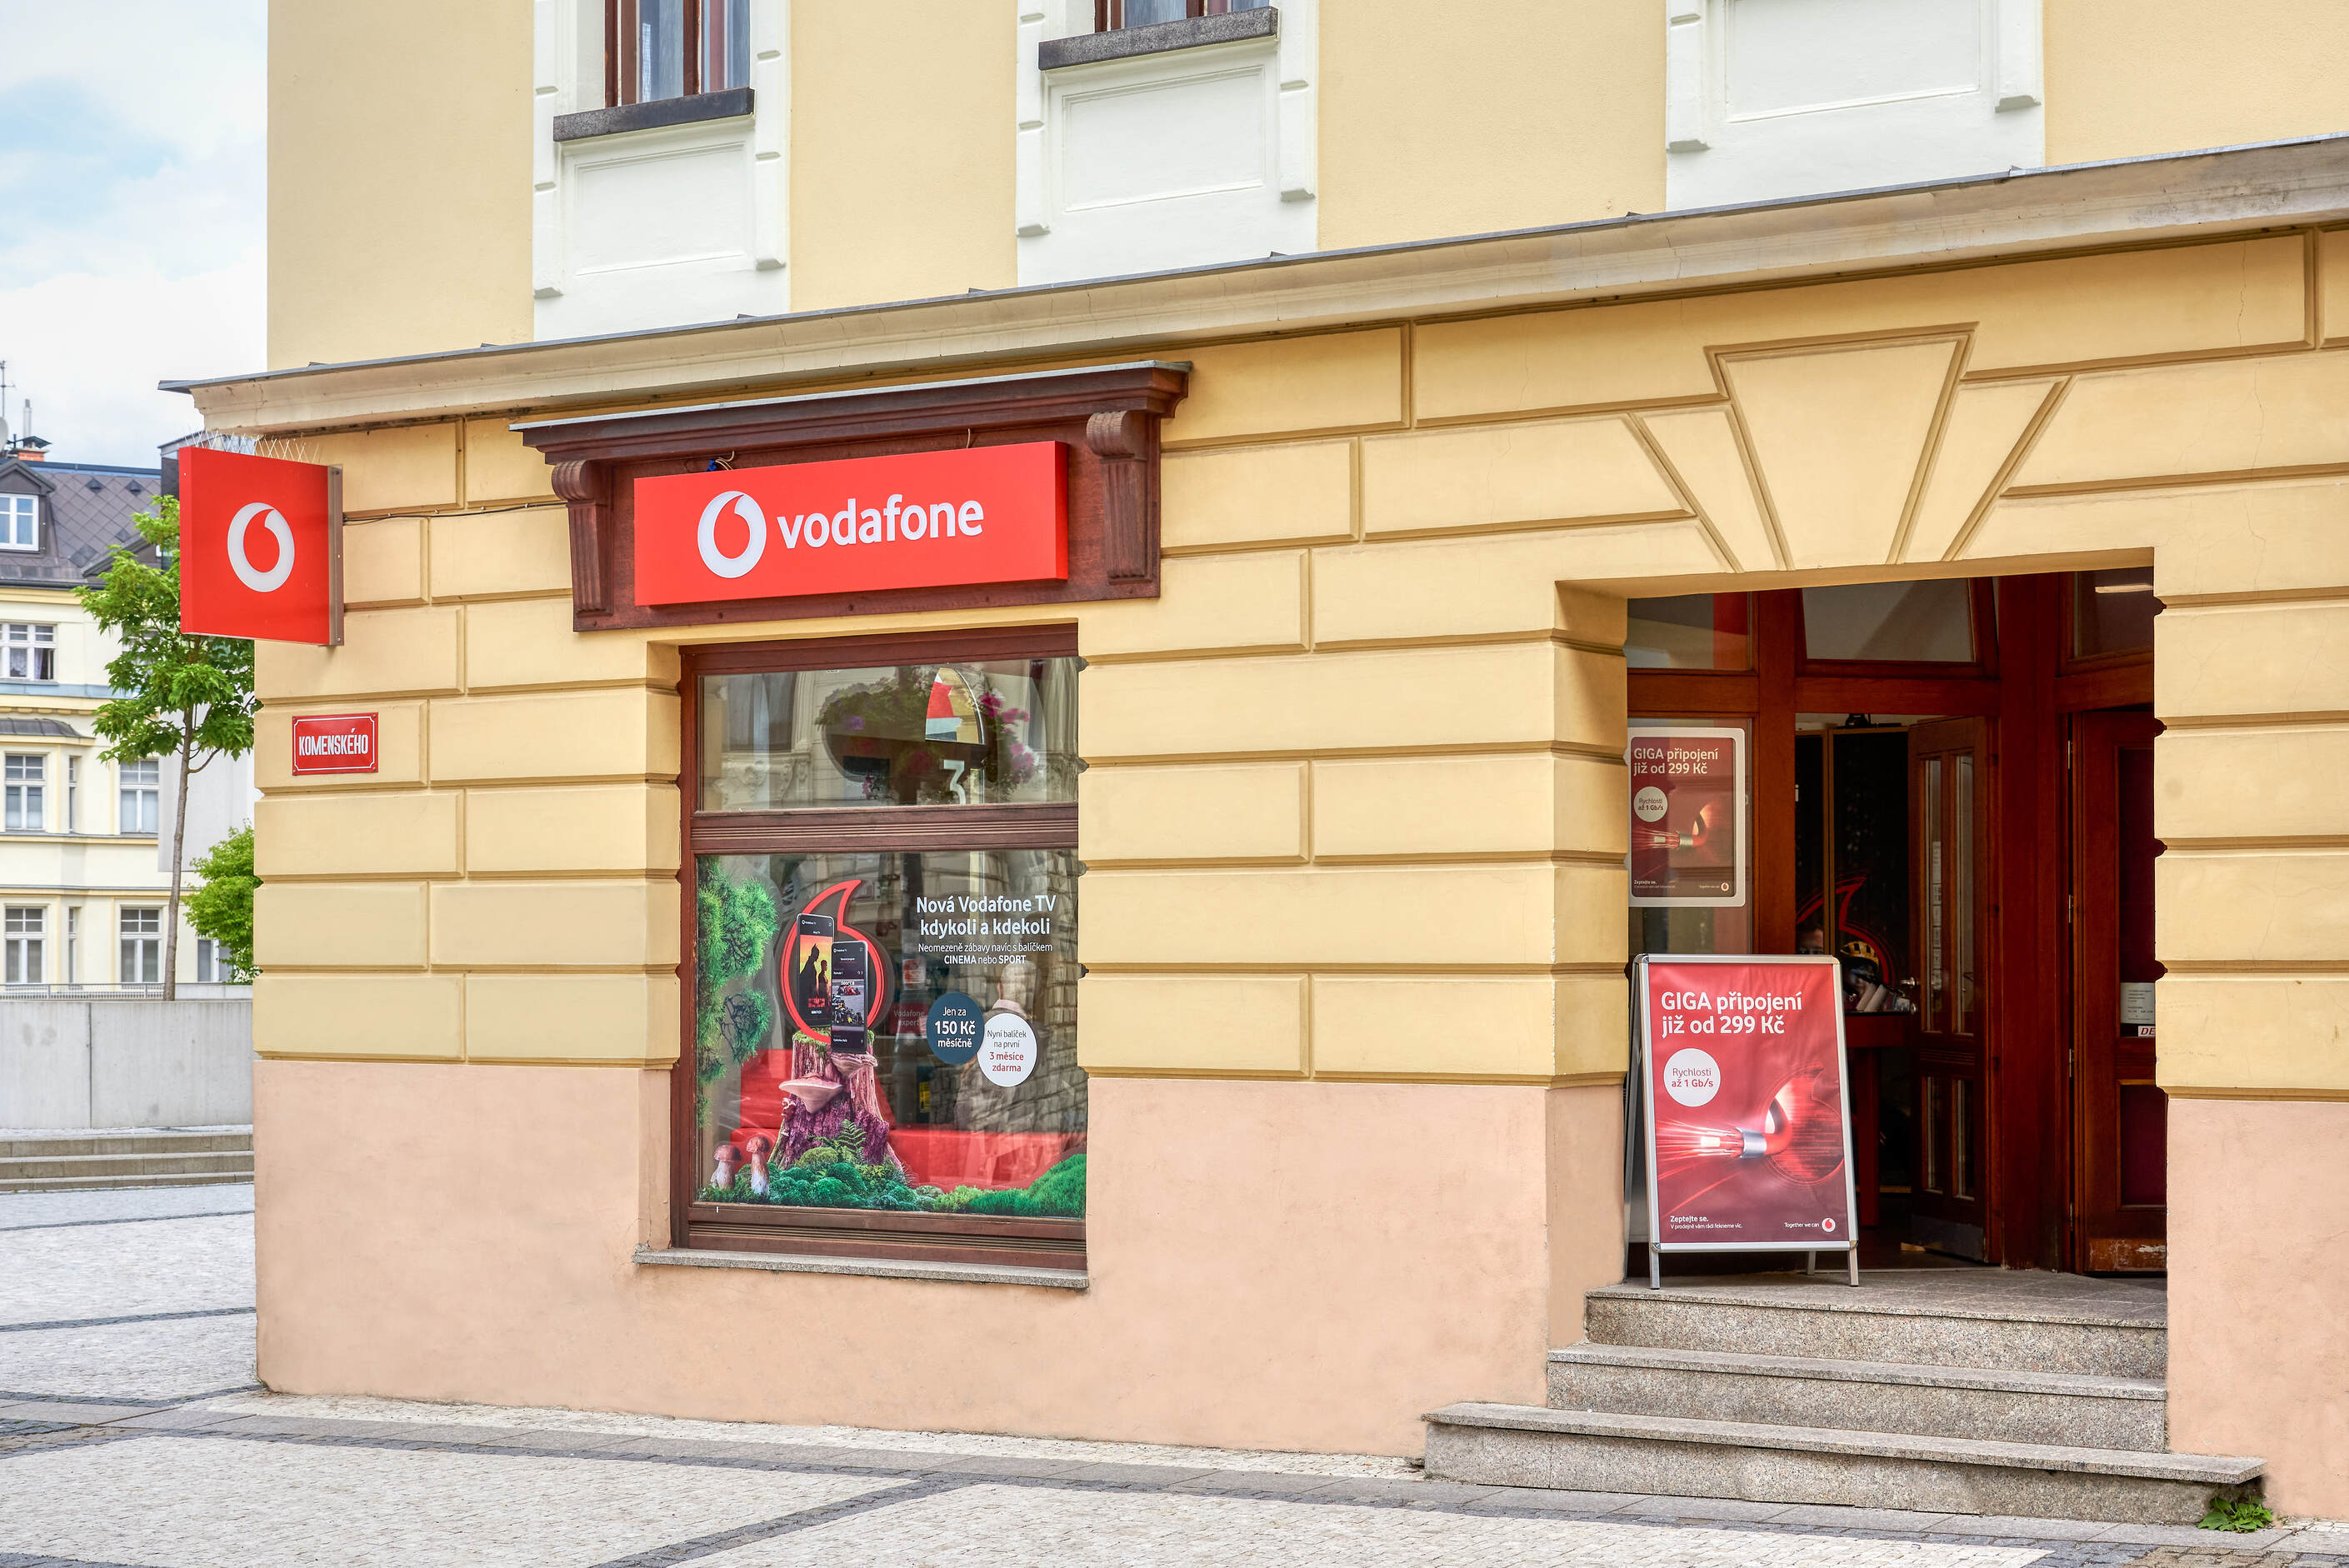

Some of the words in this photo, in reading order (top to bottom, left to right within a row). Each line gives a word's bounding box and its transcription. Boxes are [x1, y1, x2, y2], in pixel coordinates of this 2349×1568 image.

[777, 494, 984, 549] vodafone
[299, 727, 368, 756] KOMENSKÉHO
[1633, 747, 1664, 759] GIGA
[1667, 747, 1719, 762] připojení
[1633, 762, 1647, 777] již
[1650, 762, 1666, 774] od
[1668, 762, 1690, 774] 299
[1692, 762, 1707, 774] Kč
[917, 895, 955, 913] Nová
[958, 895, 1032, 913] Vodafone
[1035, 895, 1057, 912] TV
[920, 918, 977, 940] kdykoli
[980, 922, 989, 935] a
[992, 917, 1050, 935] kdekoli
[918, 942, 963, 952] Neomezeně
[964, 943, 991, 954] zábavy
[992, 943, 1011, 952] navíc
[1018, 942, 1052, 952] balíčkem
[944, 955, 977, 964] CINEMA
[977, 955, 997, 964] nebo
[998, 955, 1027, 964] SPORT
[1661, 991, 1712, 1011] GIGA
[1717, 991, 1802, 1015] připojení
[942, 1006, 957, 1016] Jen
[957, 1008, 967, 1016] za
[934, 1020, 957, 1035] 150
[960, 1020, 976, 1035] Kč
[1662, 1014, 1685, 1039] již
[1689, 1015, 1714, 1034] od
[1719, 1015, 1756, 1034] 299
[1761, 1014, 1785, 1034] Kč
[987, 1029, 1002, 1040] Nyní
[1003, 1029, 1027, 1038] balíček
[937, 1038, 972, 1048] měsíčně
[1002, 1040, 1020, 1050] první
[989, 1051, 995, 1060] 3
[996, 1051, 1024, 1061] měsíce
[992, 1063, 1022, 1072] zdarma
[1672, 1067, 1712, 1078] Rychlosti
[1672, 1079, 1682, 1087] až
[1685, 1079, 1688, 1087] 1
[1692, 1079, 1714, 1088] Gb/s
